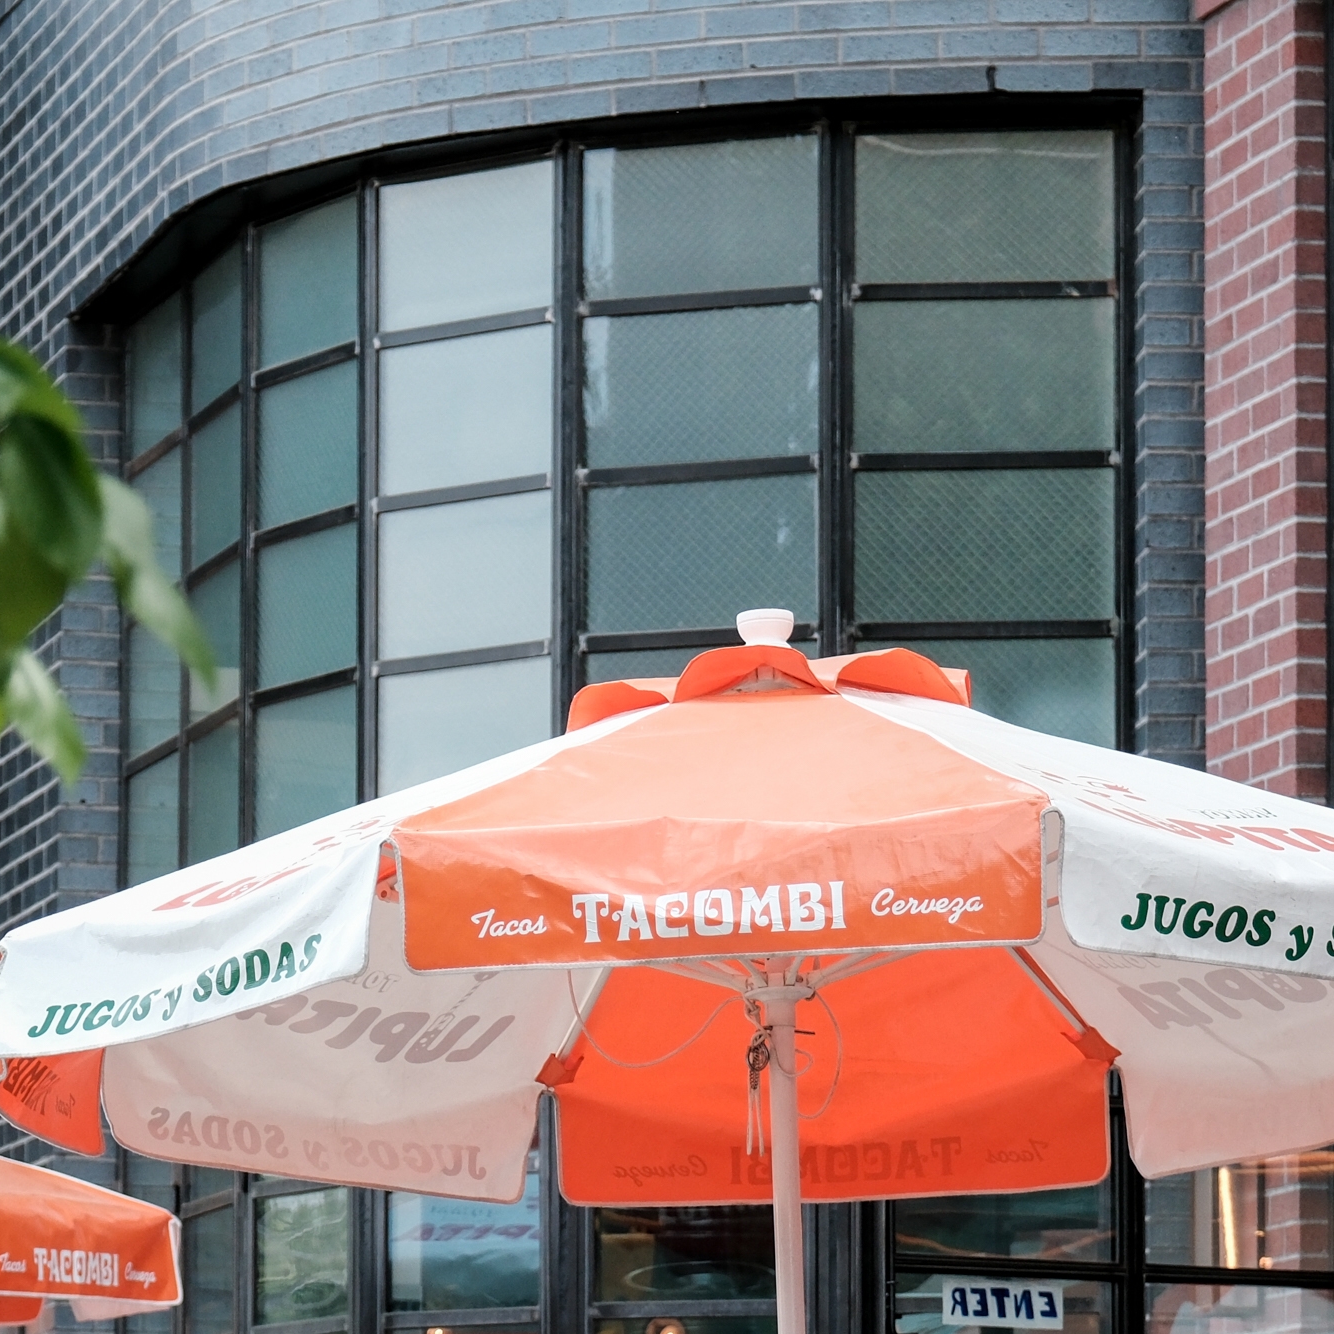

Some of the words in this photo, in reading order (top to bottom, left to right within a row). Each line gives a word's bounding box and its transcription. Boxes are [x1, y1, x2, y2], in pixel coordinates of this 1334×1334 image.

[471, 909, 548, 939] Tacos
[572, 880, 845, 943] TACOMBI
[870, 888, 983, 924] Cerveza
[1121, 892, 1277, 947] JUGOS
[1284, 924, 1314, 961] y
[27, 988, 162, 1038] JUGOS
[162, 984, 184, 1021] y
[193, 933, 323, 1003] SODAS
[33, 1247, 120, 1287] TACOMBI
